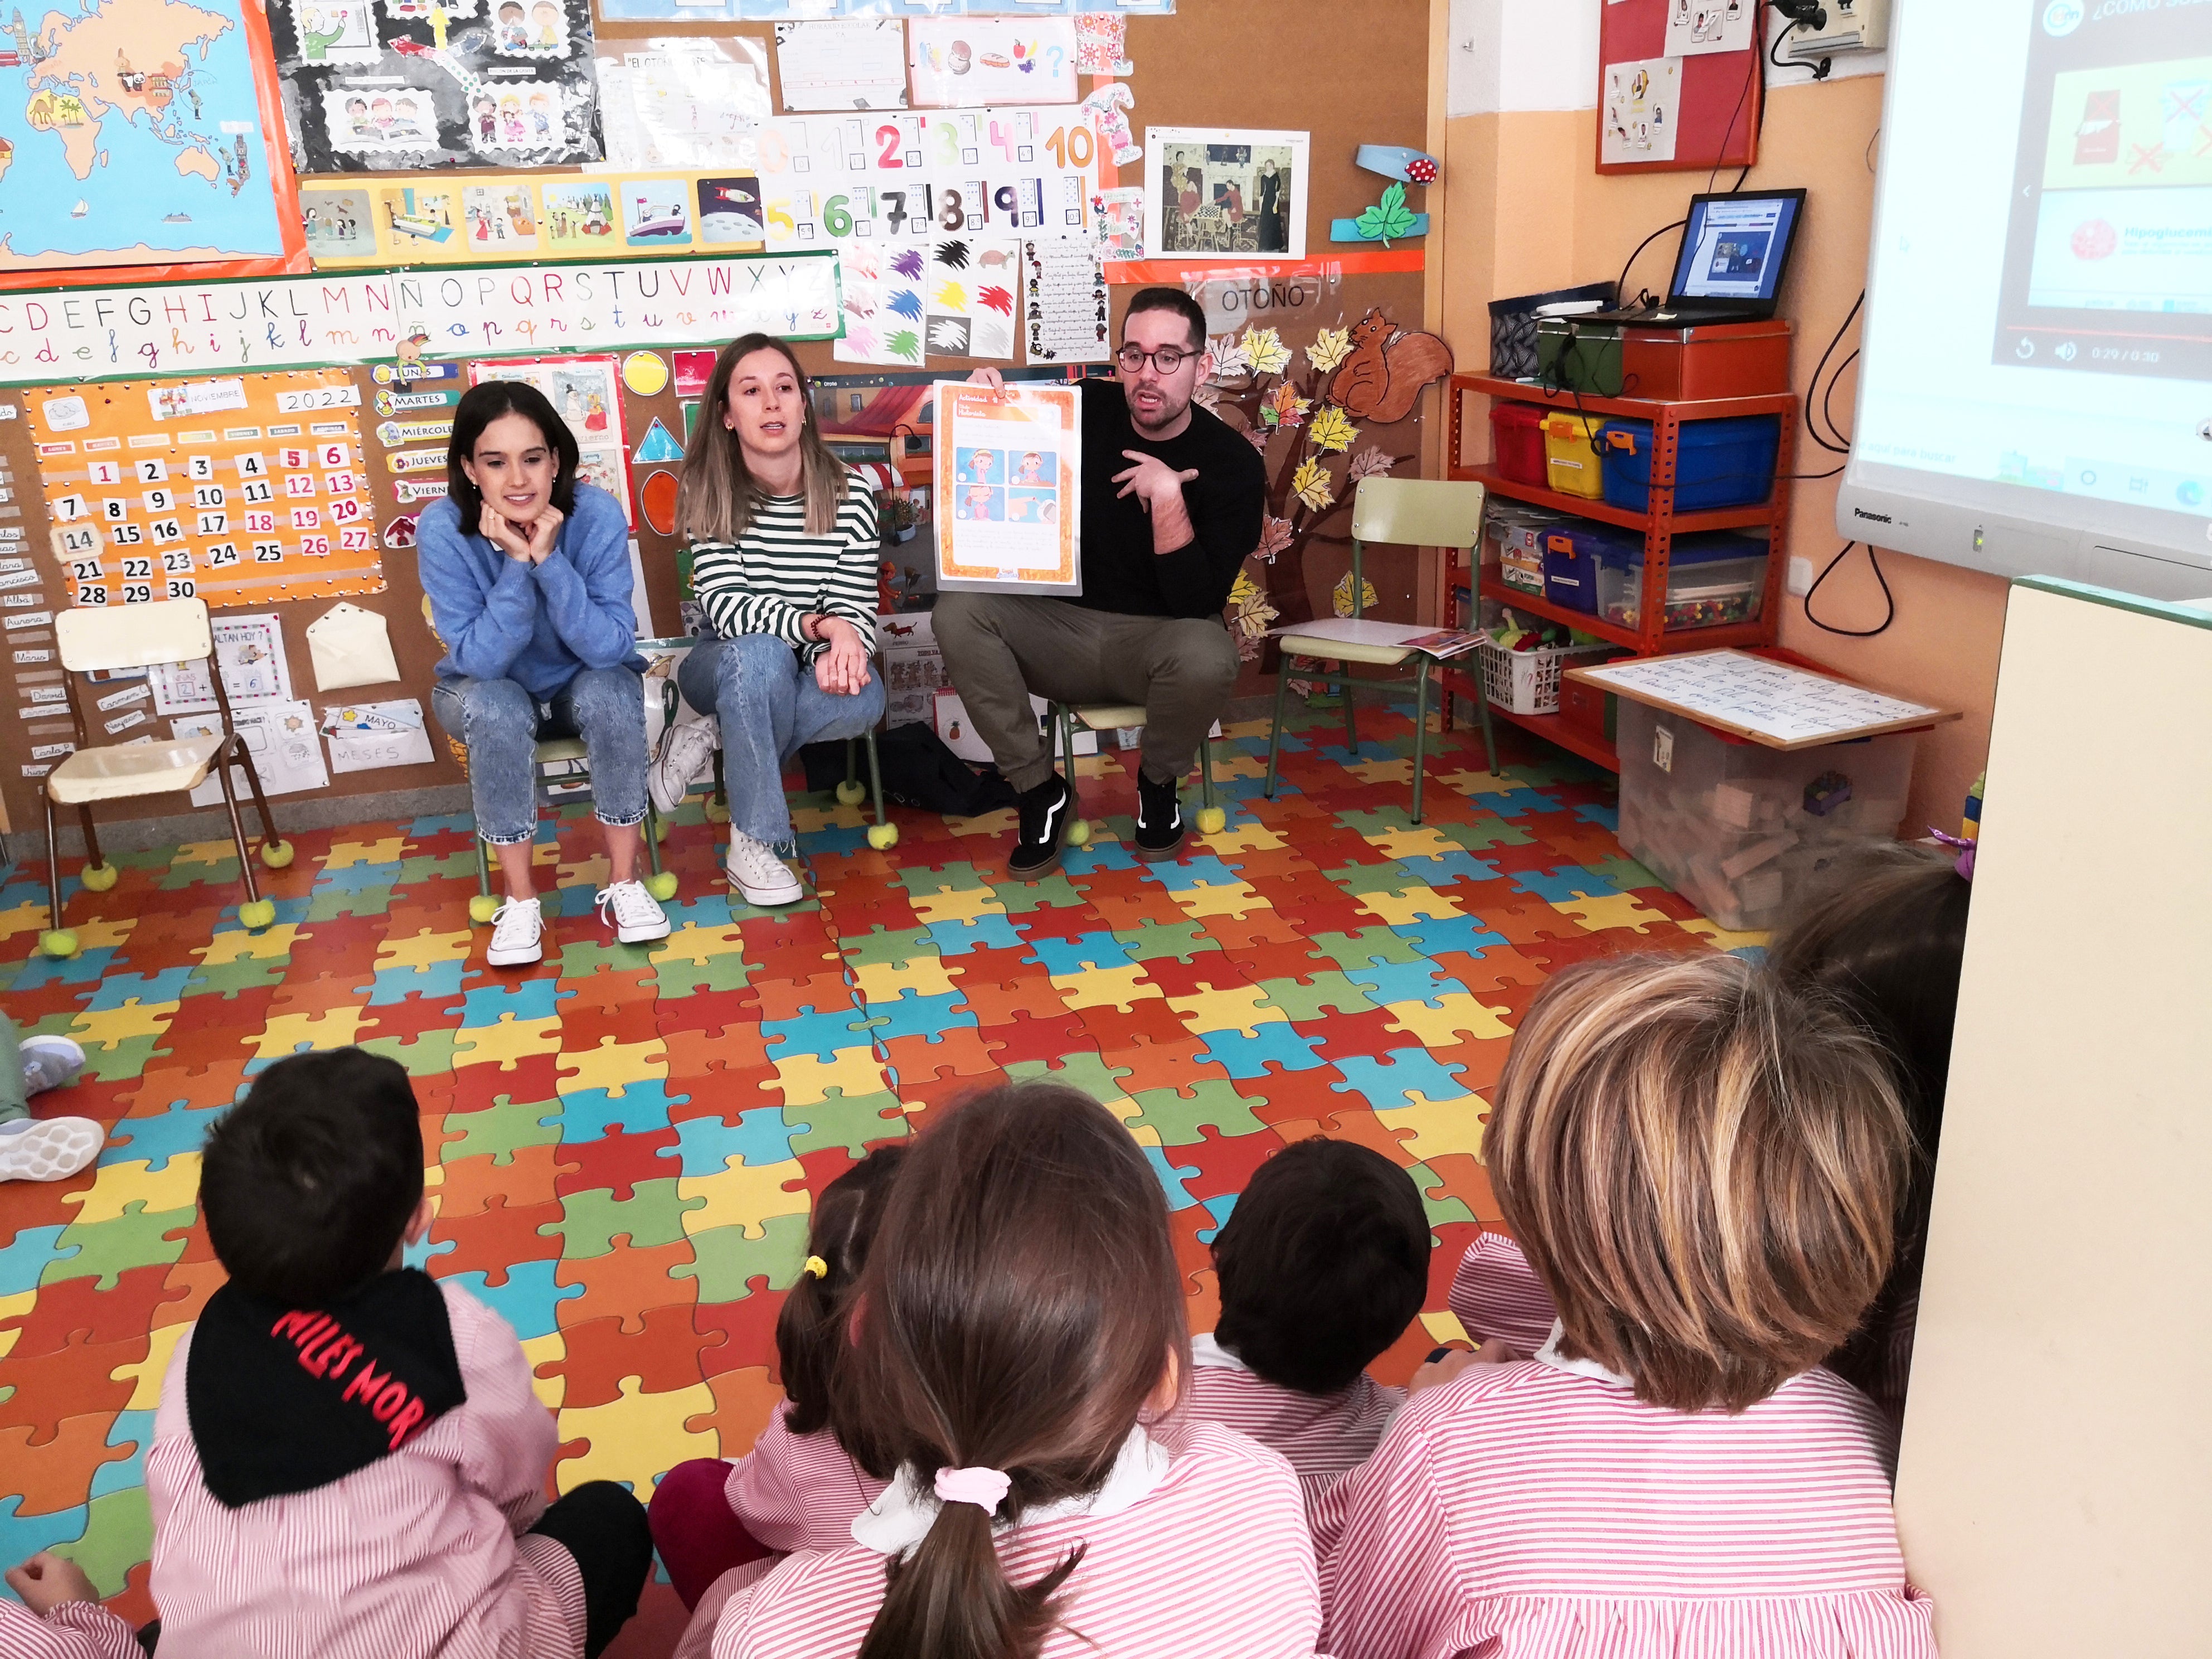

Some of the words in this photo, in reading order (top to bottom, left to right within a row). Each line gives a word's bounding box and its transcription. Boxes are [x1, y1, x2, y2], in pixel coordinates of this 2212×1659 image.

[759, 129, 788, 174] 0
[821, 127, 843, 171] 1
[875, 125, 904, 168] 2
[933, 122, 959, 166] 3
[989, 120, 1016, 163] 4
[1045, 126, 1094, 168] 10
[767, 197, 794, 241] 5
[823, 195, 853, 237] 6
[880, 191, 908, 235] 7
[938, 189, 964, 231] 8
[995, 186, 1019, 228] 9
[26, 303, 48, 331] D
[64, 300, 85, 328] E
[95, 299, 114, 327] F
[128, 297, 151, 325] G
[163, 295, 188, 323] H
[198, 294, 217, 322] I
[230, 292, 247, 319] J
[258, 290, 279, 318] K
[289, 289, 308, 316] L
[322, 287, 350, 313] M
[365, 284, 390, 312] N
[400, 279, 423, 309] Ñ
[441, 278, 463, 307] O
[478, 278, 495, 305] P
[511, 276, 534, 307] Q
[544, 274, 564, 302] R
[576, 273, 593, 300] S
[603, 271, 625, 299] T
[638, 270, 658, 298] U
[670, 268, 692, 295] V
[707, 266, 730, 295] W
[1222, 283, 1304, 312] OTOÑO
[35, 337, 59, 362] d
[72, 346, 94, 360] e
[109, 329, 119, 363] f
[138, 342, 159, 368] g
[172, 328, 195, 354] h
[210, 333, 221, 352] i
[239, 329, 251, 363] j
[266, 322, 285, 350] k
[299, 319, 312, 346] l
[326, 329, 360, 345] m
[372, 328, 395, 342] n
[447, 323, 470, 336] o
[483, 321, 502, 346] p
[515, 319, 537, 345] q
[550, 318, 567, 332] r
[580, 317, 596, 331] s
[612, 304, 625, 328] t
[643, 313, 663, 327] u
[676, 312, 697, 325] v
[784, 308, 799, 331] y
[811, 309, 828, 319] z
[396, 368, 431, 377] LUNS
[191, 390, 240, 402] NOVIEMBRE
[395, 395, 440, 406] MARTES
[958, 394, 988, 403] Actividad
[412, 455, 447, 466] JUEVES
[1893, 447, 1916, 459] para
[1920, 449, 1957, 463] buscar
[99, 465, 111, 482] 1
[145, 463, 159, 480] 2
[195, 460, 207, 474] 3
[245, 458, 258, 473] 4
[288, 451, 300, 467] 5
[327, 447, 341, 464] 6
[63, 499, 75, 516] 7
[109, 503, 120, 517] 8
[152, 492, 164, 508] 9
[197, 488, 222, 505] 10
[245, 483, 271, 501] 11
[288, 477, 313, 494] 12
[328, 474, 353, 492] 13
[1855, 507, 1892, 524] Panasonic
[66, 531, 93, 550] 14
[114, 526, 140, 544] 15
[154, 522, 178, 538] 16
[201, 515, 225, 532] 17
[248, 515, 273, 530] 18
[294, 511, 318, 527] 19
[333, 501, 357, 520] 20
[74, 561, 103, 580] 21
[124, 560, 151, 577] 22
[164, 553, 191, 570] 23
[210, 545, 237, 564] 24
[255, 545, 281, 561] 25
[303, 538, 328, 554] 26
[342, 532, 366, 547] 27
[6, 596, 30, 605] Alba
[80, 586, 106, 603] 28
[124, 586, 150, 603] 29
[168, 581, 194, 598] 30
[7, 617, 44, 626] Aurora
[241, 632, 255, 642] HOY
[365, 715, 396, 730] MAYO
[338, 747, 399, 760] MESES
[270, 1310, 364, 1380] MILES
